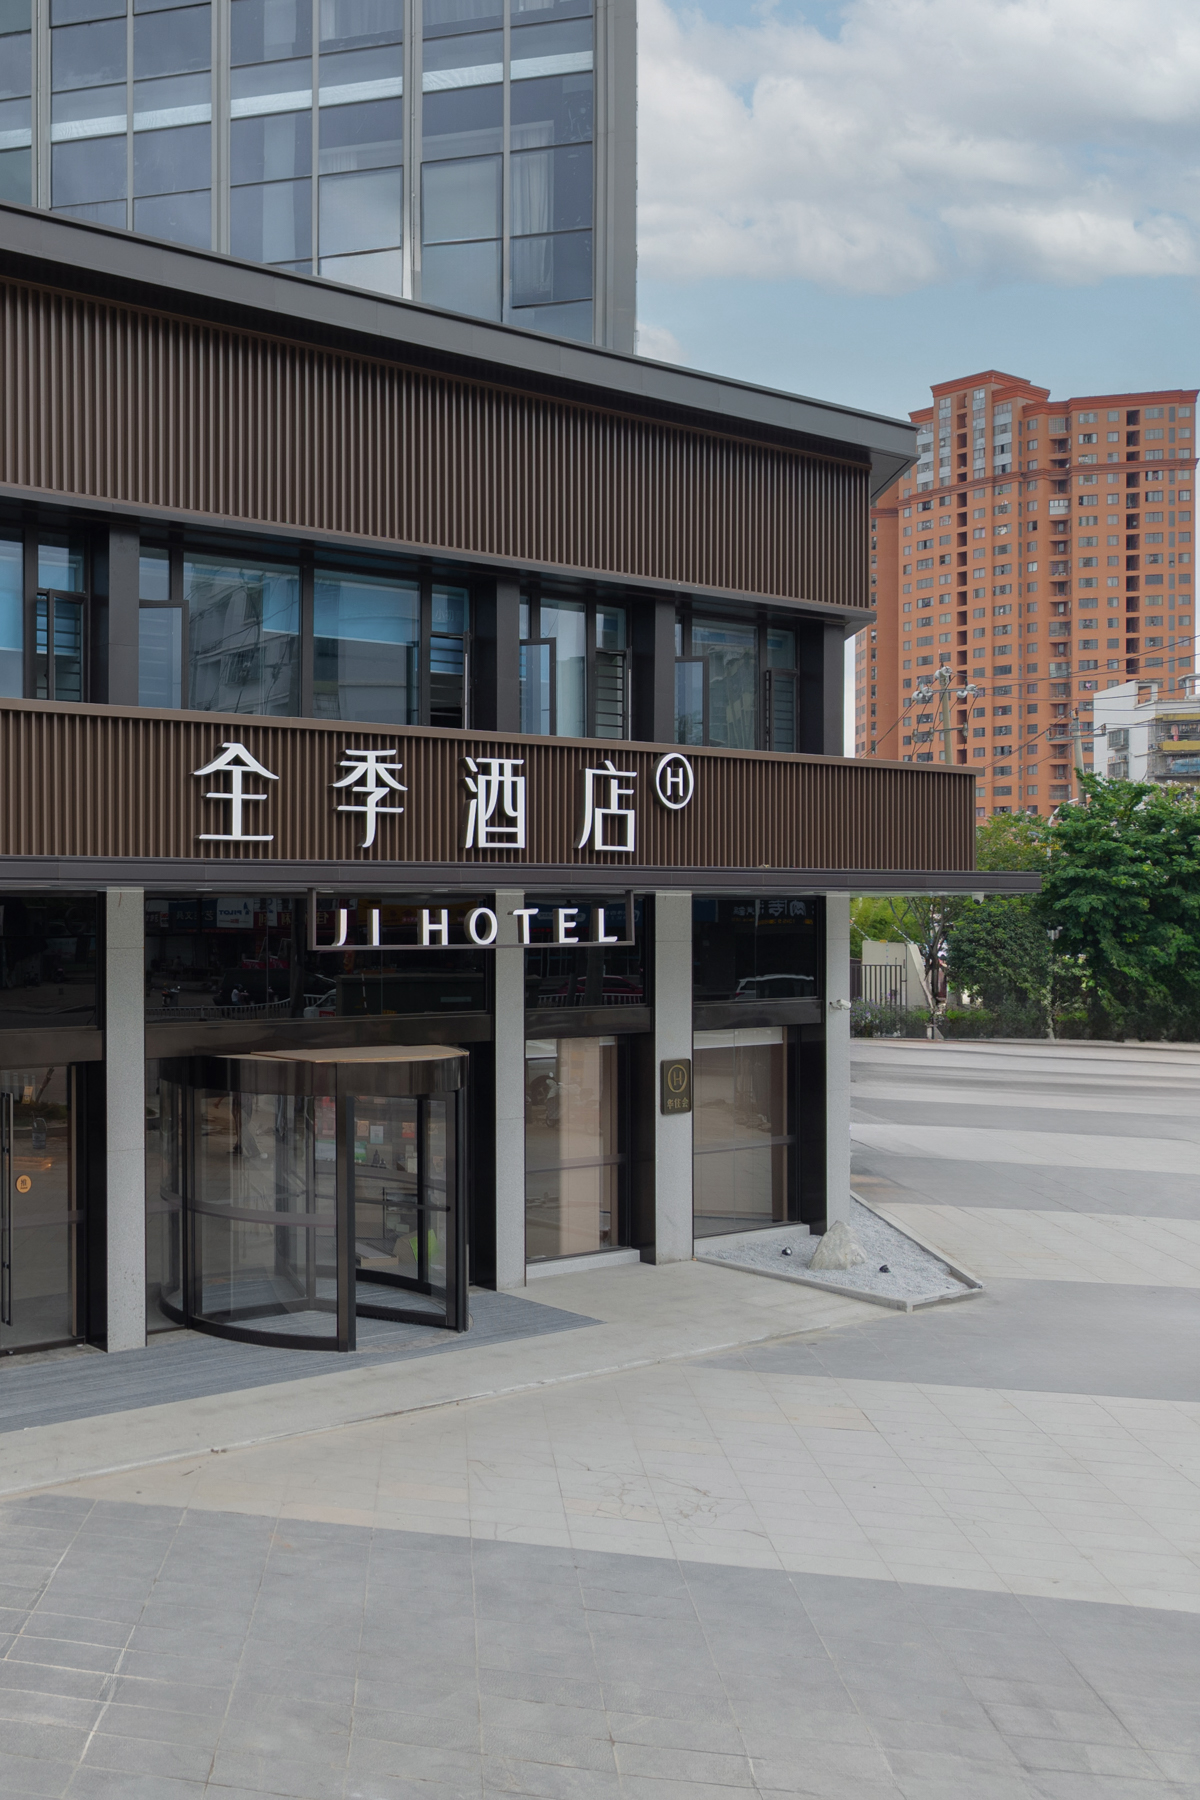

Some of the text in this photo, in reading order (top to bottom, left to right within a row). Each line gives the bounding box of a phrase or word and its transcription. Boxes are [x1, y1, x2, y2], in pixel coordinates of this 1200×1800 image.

[191, 742, 637, 851] 全季酒店
[333, 908, 380, 946] JI
[419, 907, 618, 945] HOTEL
